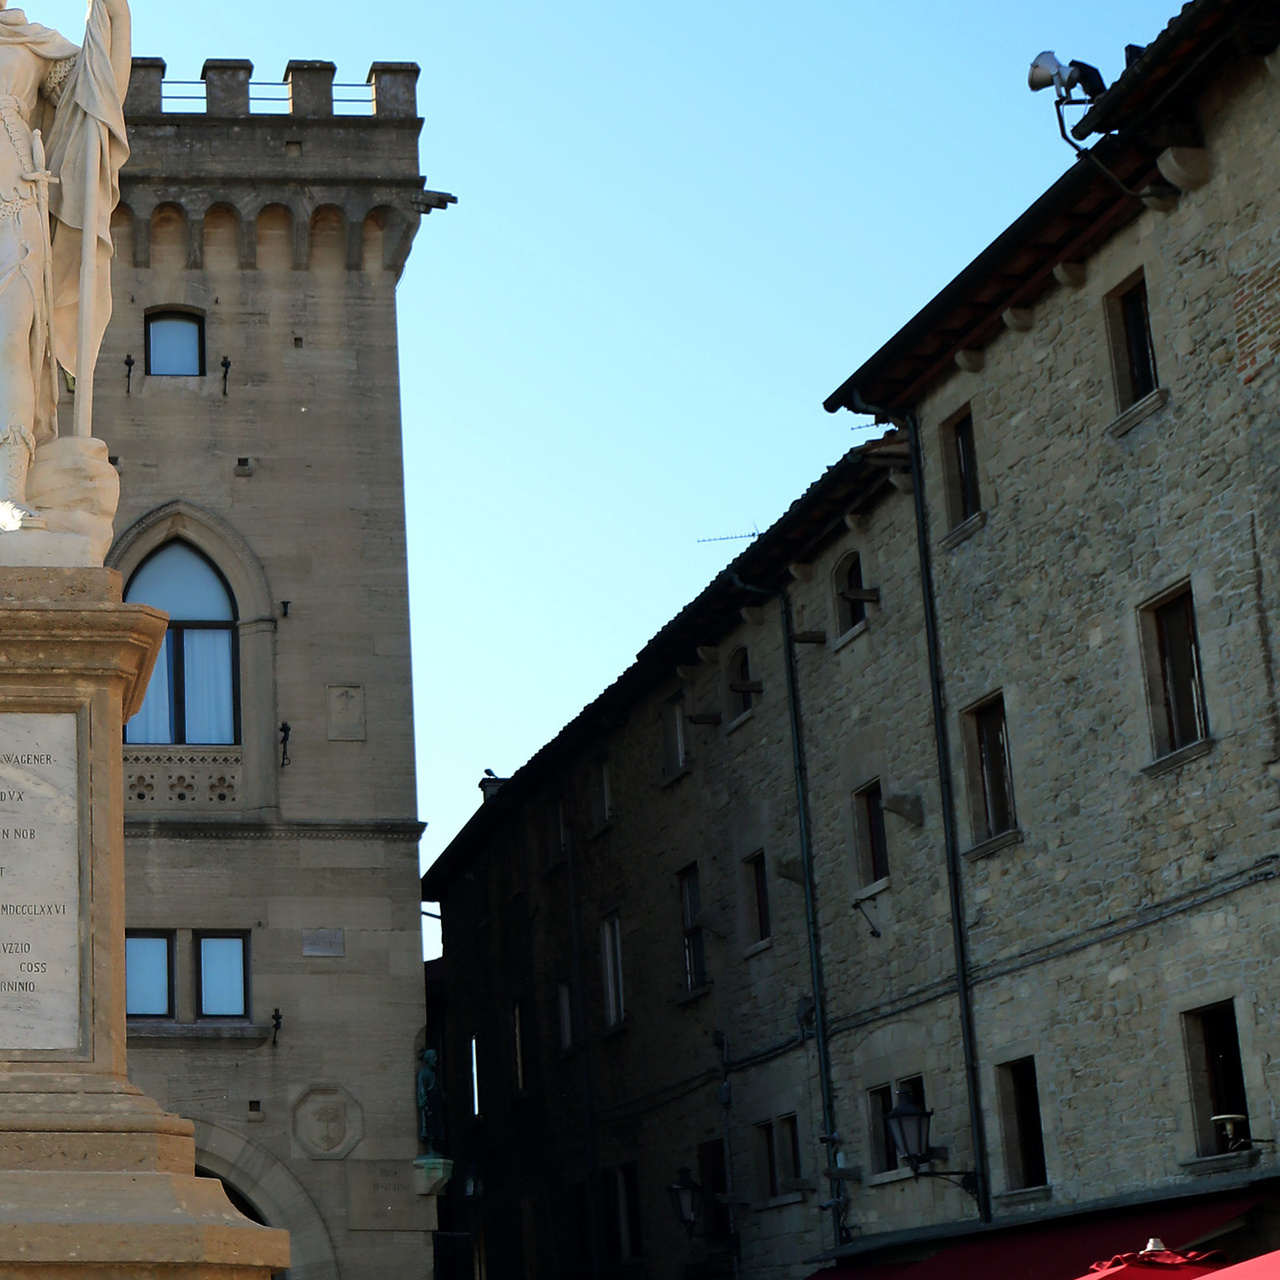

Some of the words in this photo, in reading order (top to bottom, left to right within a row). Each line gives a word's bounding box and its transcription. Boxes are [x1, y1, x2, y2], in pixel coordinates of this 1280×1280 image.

[0, 791, 25, 802] DVX
[14, 828, 36, 840] NOB
[1, 904, 66, 916] MDCCCLXXVI
[20, 962, 47, 973] COSS
